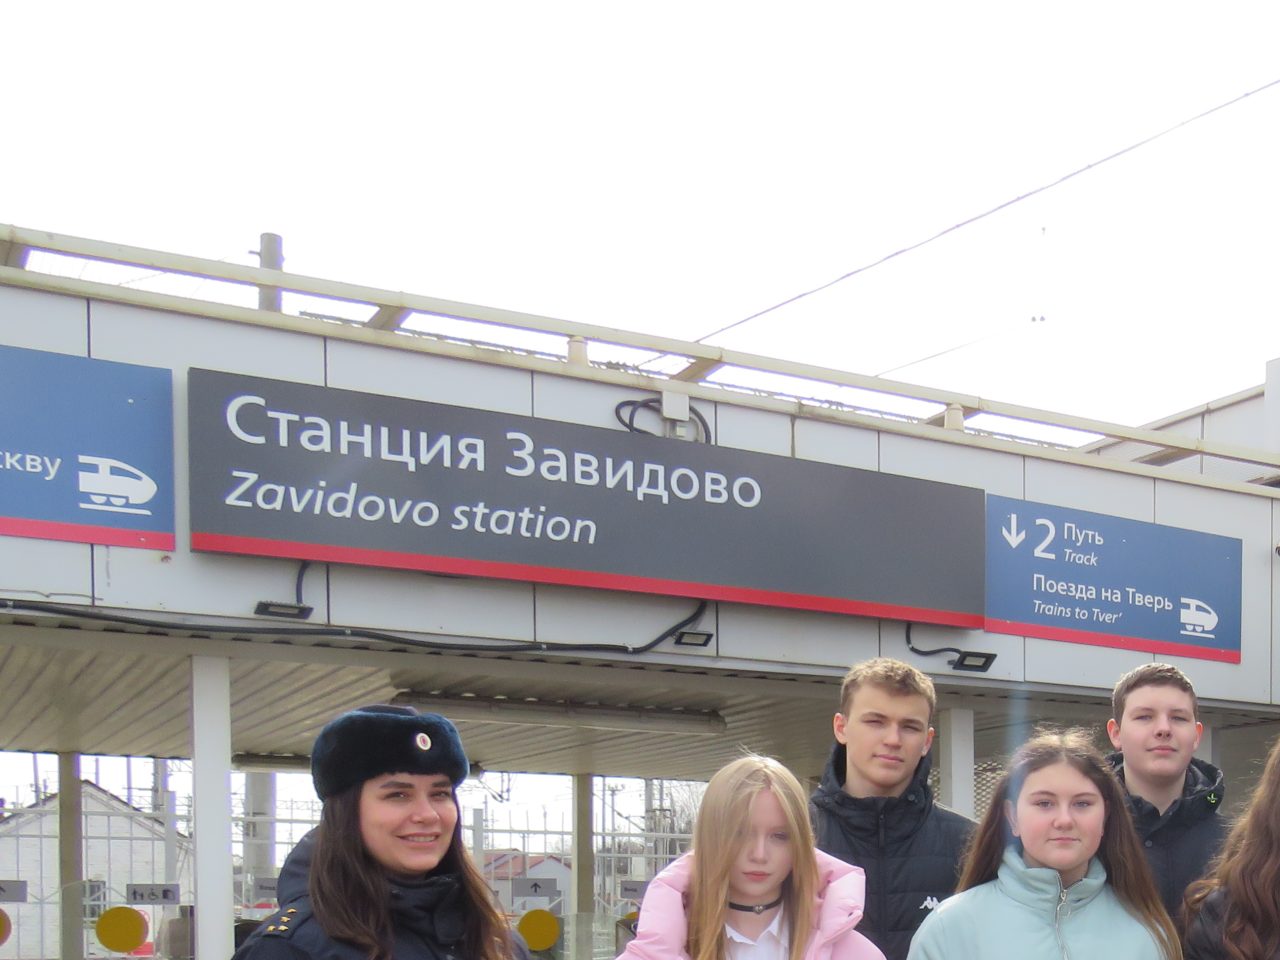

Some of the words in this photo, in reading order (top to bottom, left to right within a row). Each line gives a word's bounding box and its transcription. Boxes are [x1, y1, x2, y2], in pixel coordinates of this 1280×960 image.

[0, 450, 62, 481] кву
[226, 395, 485, 472] Станция
[505, 431, 762, 508] Завидово
[225, 470, 440, 527] Zavidovo
[451, 501, 597, 545] station
[1033, 518, 1056, 560] 2
[1063, 522, 1104, 546] Путь
[1063, 548, 1099, 567] Track
[1033, 573, 1097, 601] Поезда
[1101, 587, 1121, 603] на
[1126, 587, 1173, 613] Тверь
[1033, 599, 1071, 618] Trains
[1074, 606, 1089, 620] to
